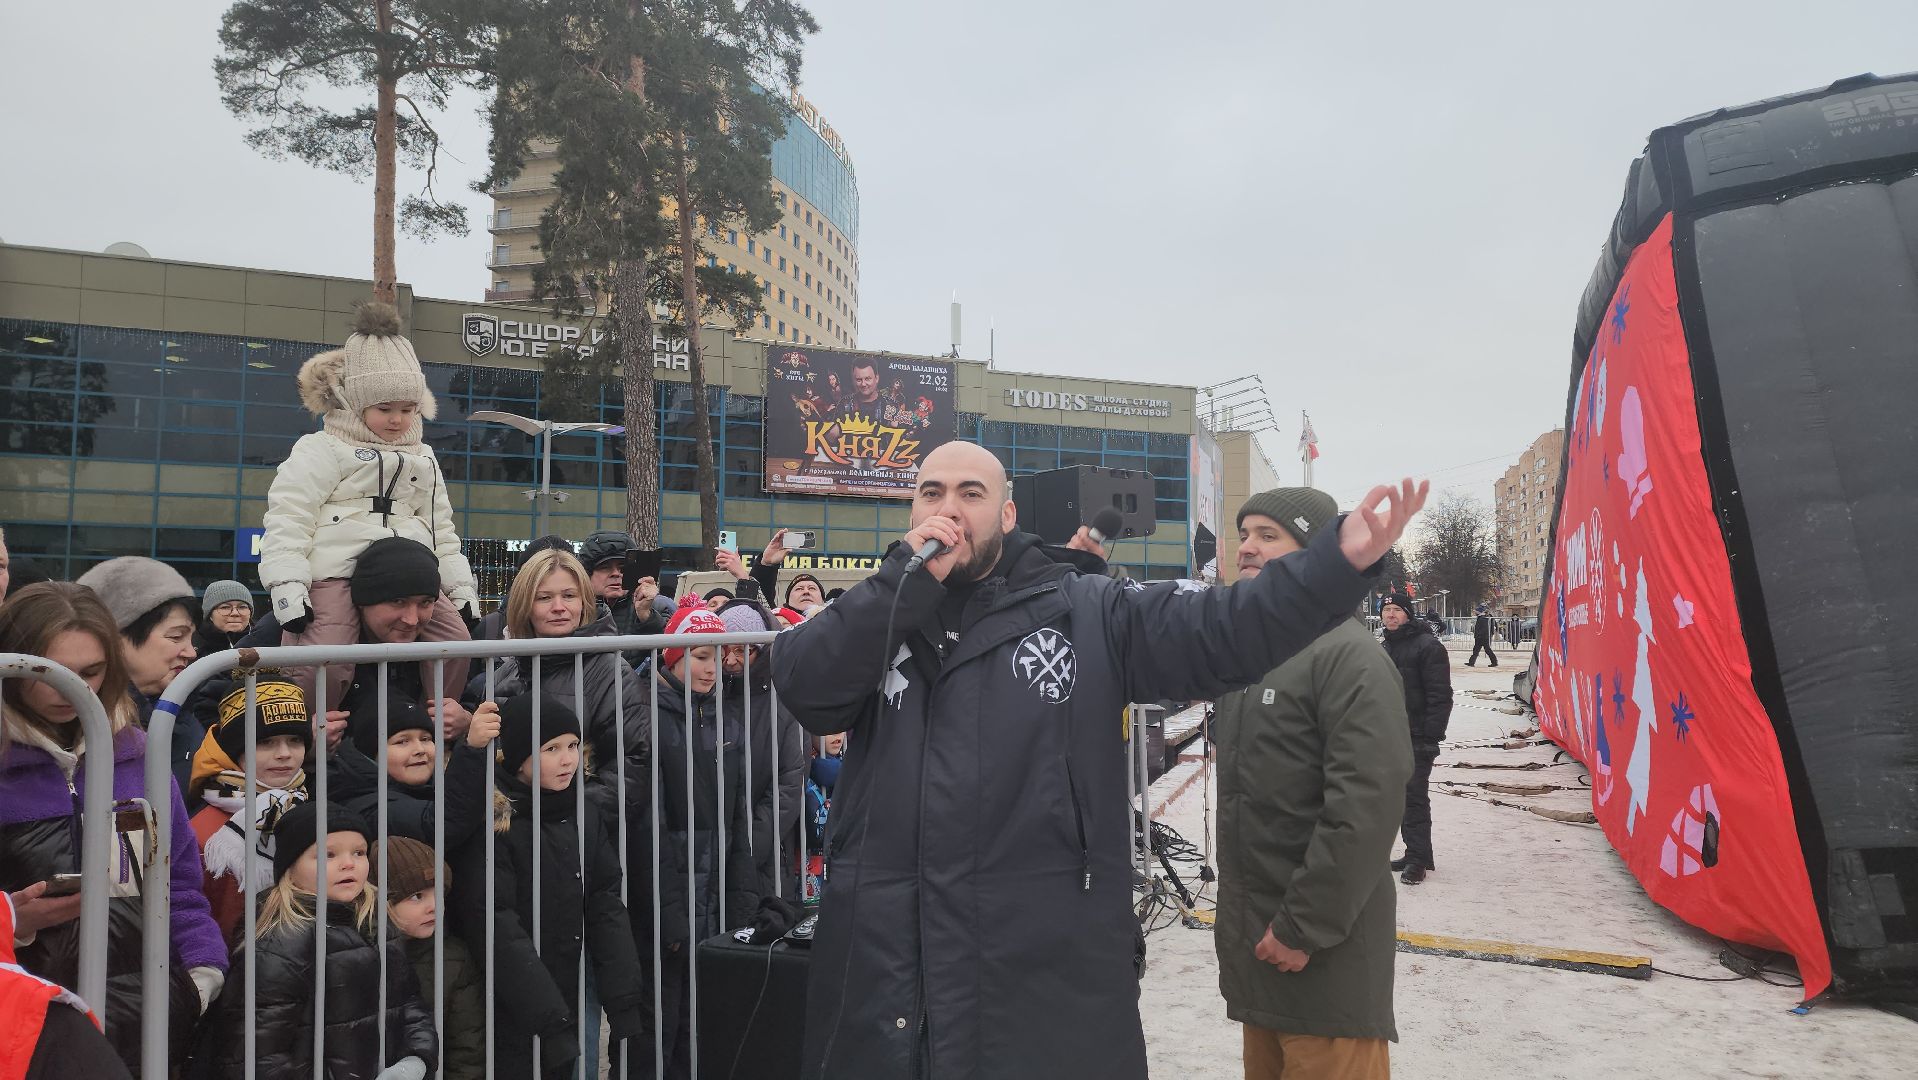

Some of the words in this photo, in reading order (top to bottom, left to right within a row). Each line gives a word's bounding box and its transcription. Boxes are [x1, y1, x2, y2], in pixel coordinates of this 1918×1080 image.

[500, 320, 581, 342] СШОР
[919, 374, 948, 387] 22.02
[1009, 388, 1089, 411] TODES
[1093, 395, 1128, 405] ШКОЛА
[1133, 398, 1168, 408] СТУДИЯ
[1094, 405, 1122, 414] АЛЛЫ
[1123, 407, 1168, 418] ДУХОВОЙ
[1040, 681, 1060, 699] 13
[266, 703, 306, 716] ADMIRAL
